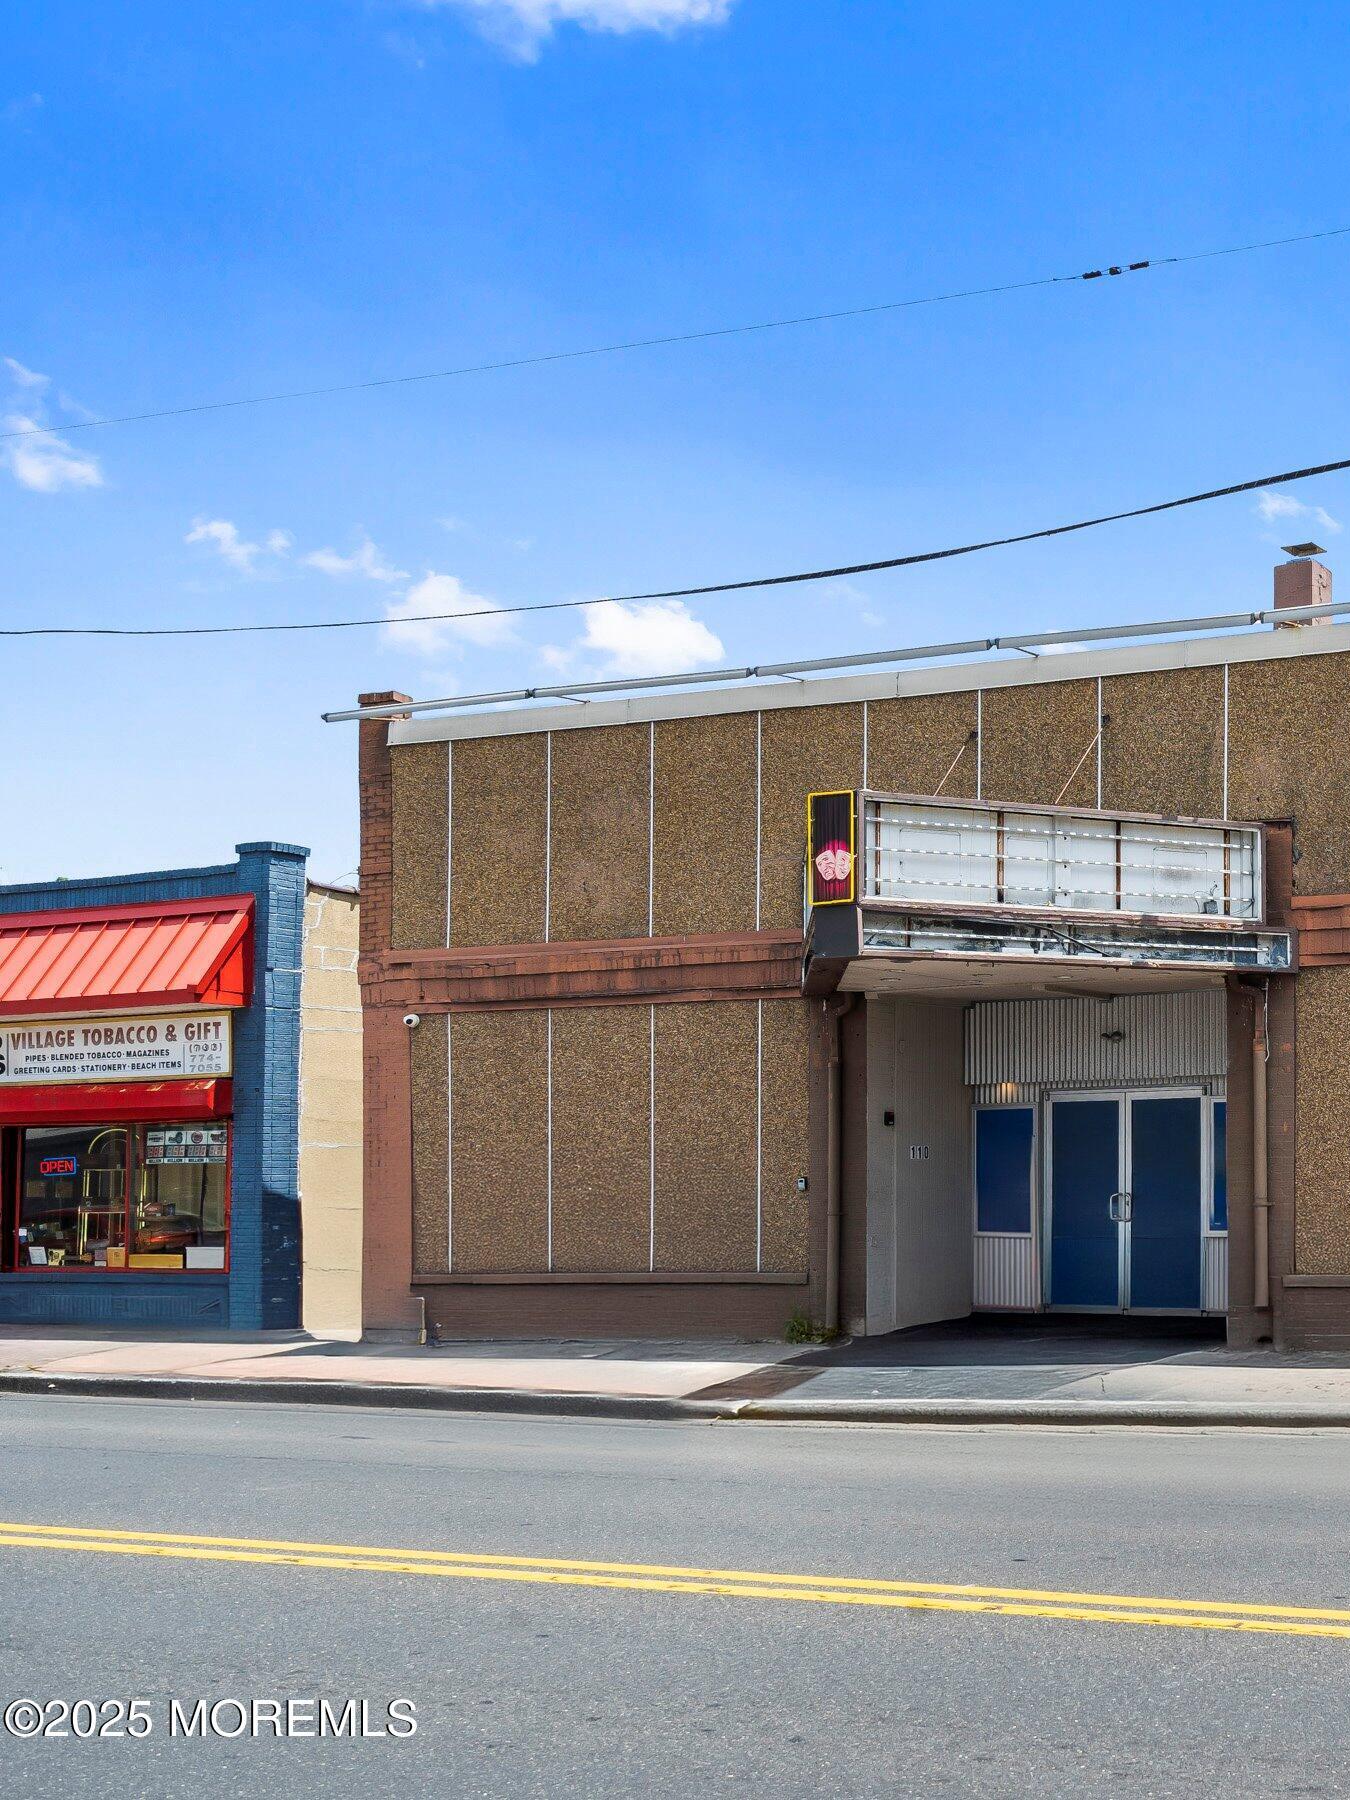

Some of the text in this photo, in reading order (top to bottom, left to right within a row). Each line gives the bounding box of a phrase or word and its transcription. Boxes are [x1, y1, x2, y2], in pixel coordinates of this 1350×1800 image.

[10, 1030, 75, 1050] VILLAGE
[82, 1025, 158, 1046] TOBACCO
[165, 1024, 177, 1042] &
[184, 1021, 222, 1041] GIFT
[25, 1049, 170, 1062] PIPES BLENDED TOBACCO MAGAZINES
[14, 1060, 182, 1075] GREETING CARDS STATIONERY BEACH ITEMS
[911, 1146, 929, 1158] 110
[40, 1160, 74, 1174] OPEN
